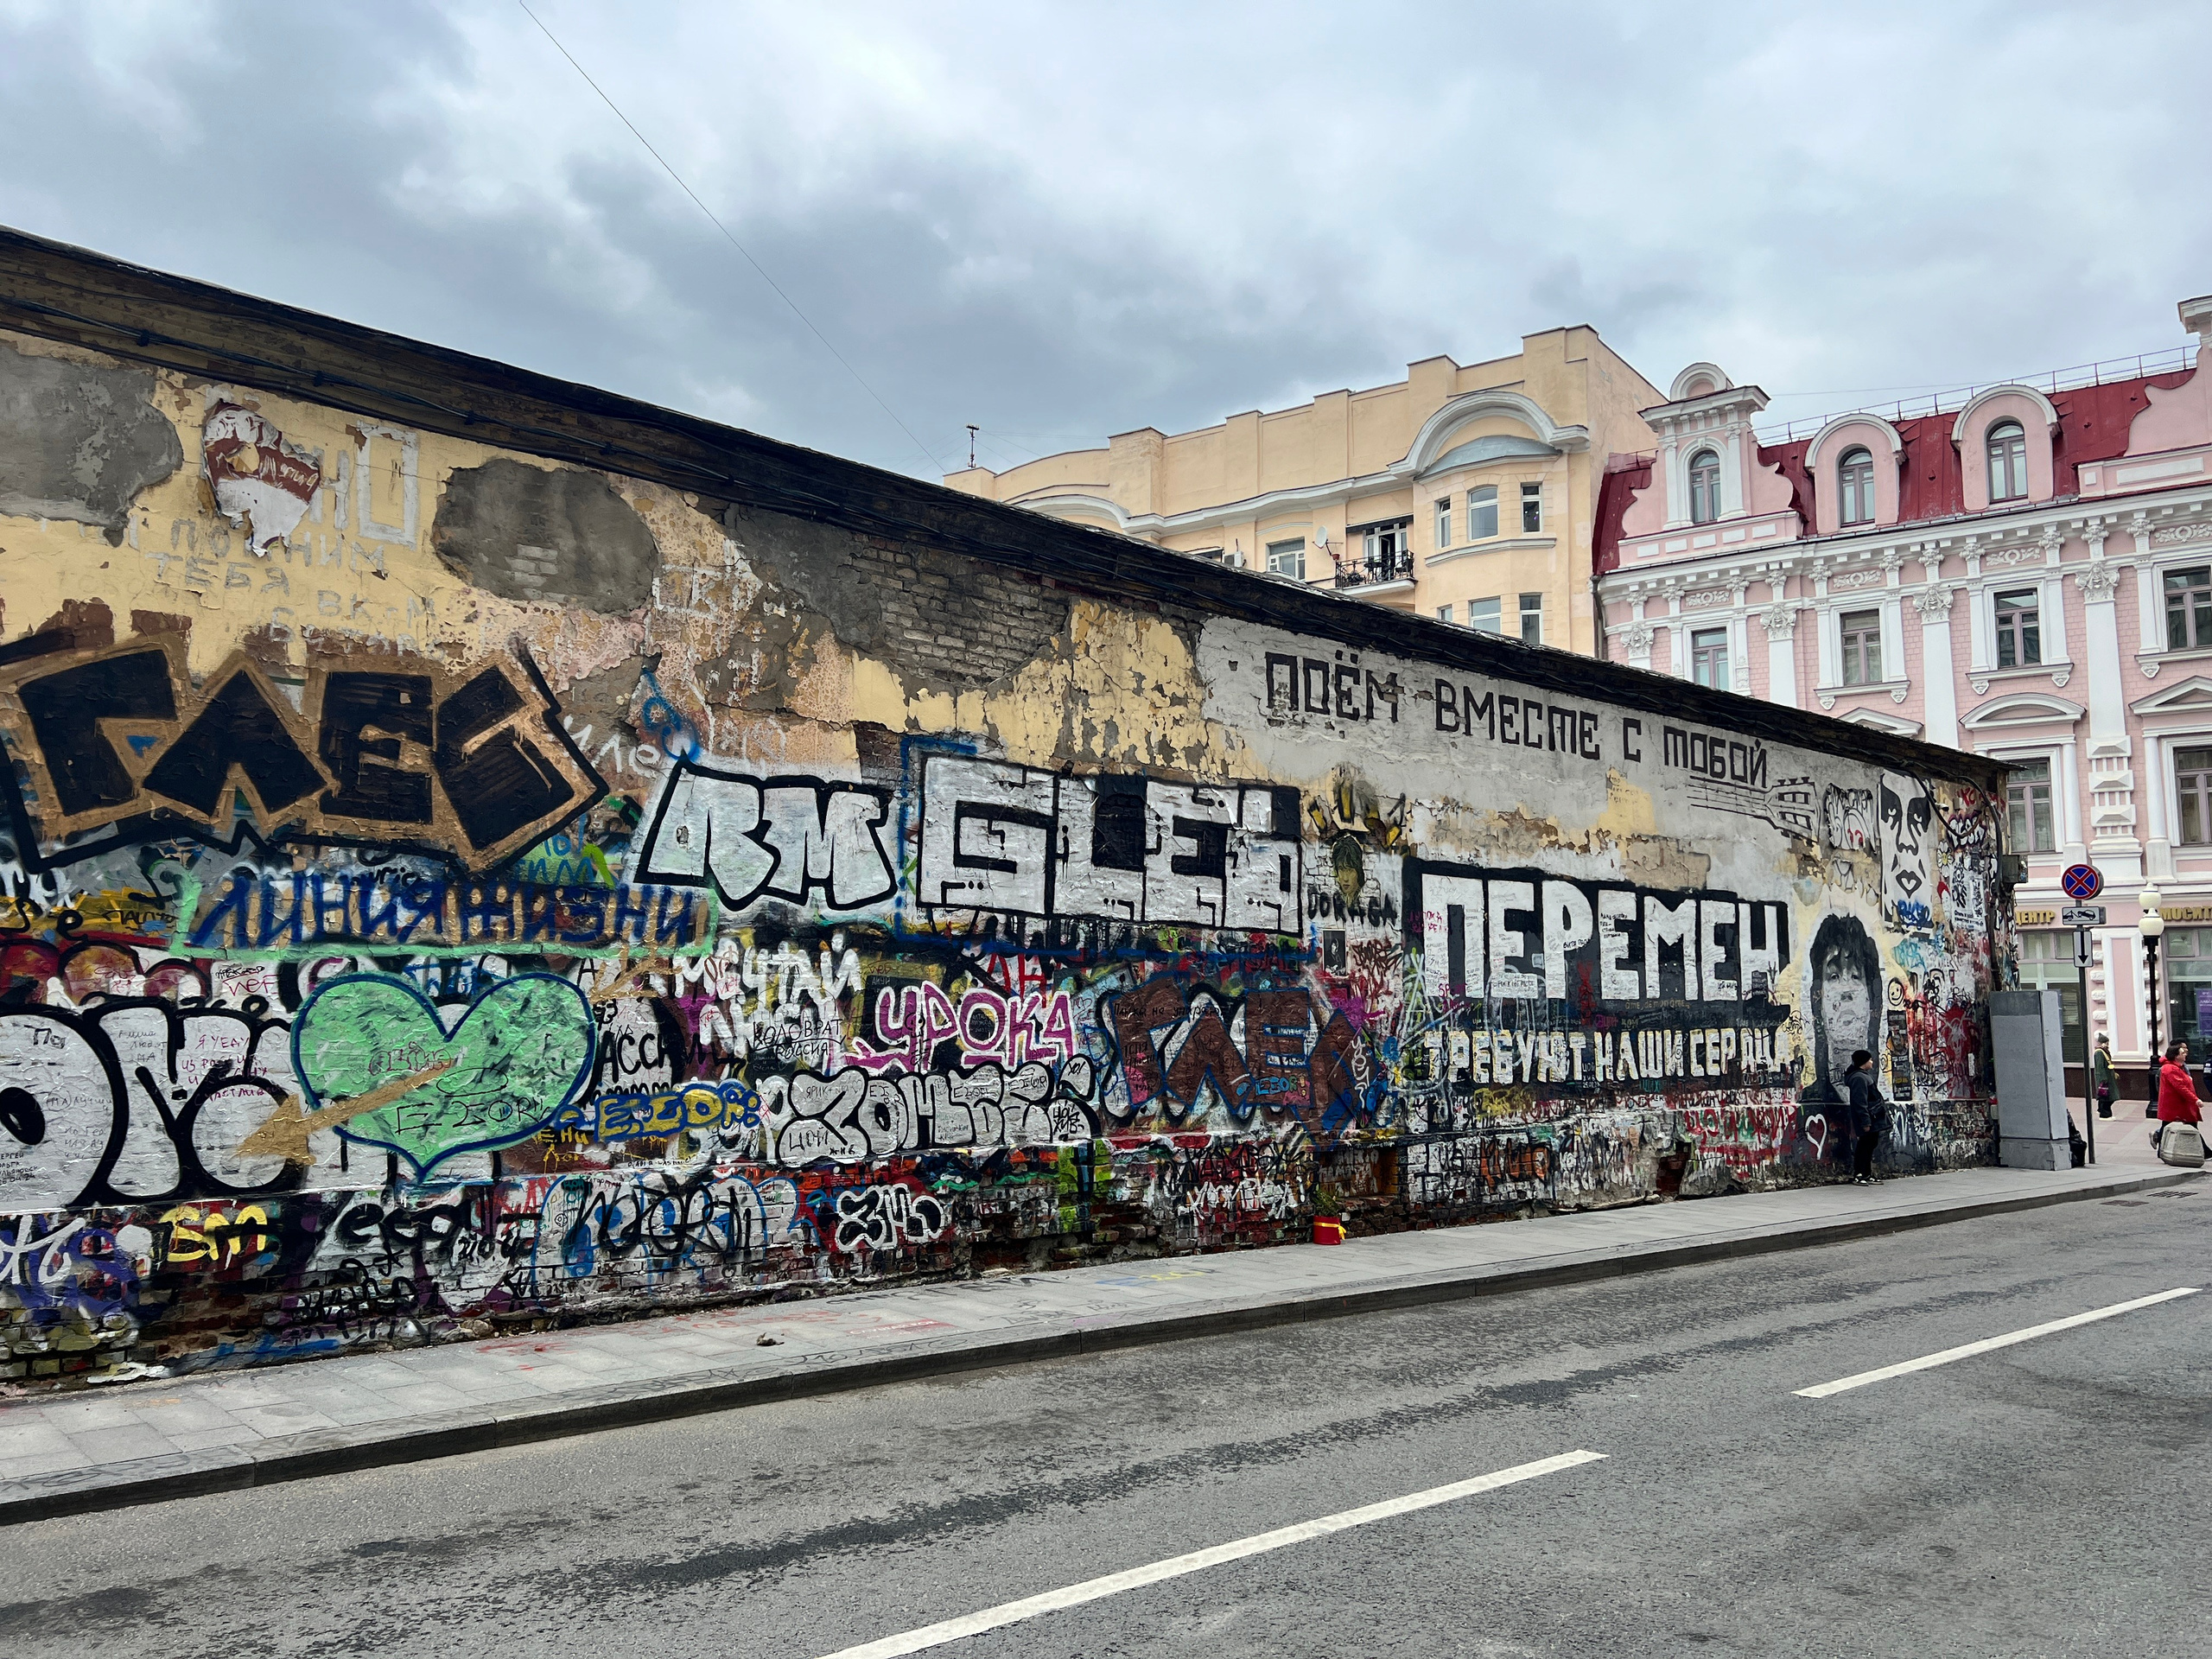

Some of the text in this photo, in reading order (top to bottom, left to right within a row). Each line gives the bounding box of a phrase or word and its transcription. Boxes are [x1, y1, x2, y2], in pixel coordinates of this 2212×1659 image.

[1265, 649, 1399, 724] ПОЁМ
[1622, 718, 1643, 763] С
[1421, 872, 1780, 1001] ПЕРЕМЕН
[1594, 1028, 1684, 1082] НАШИ
